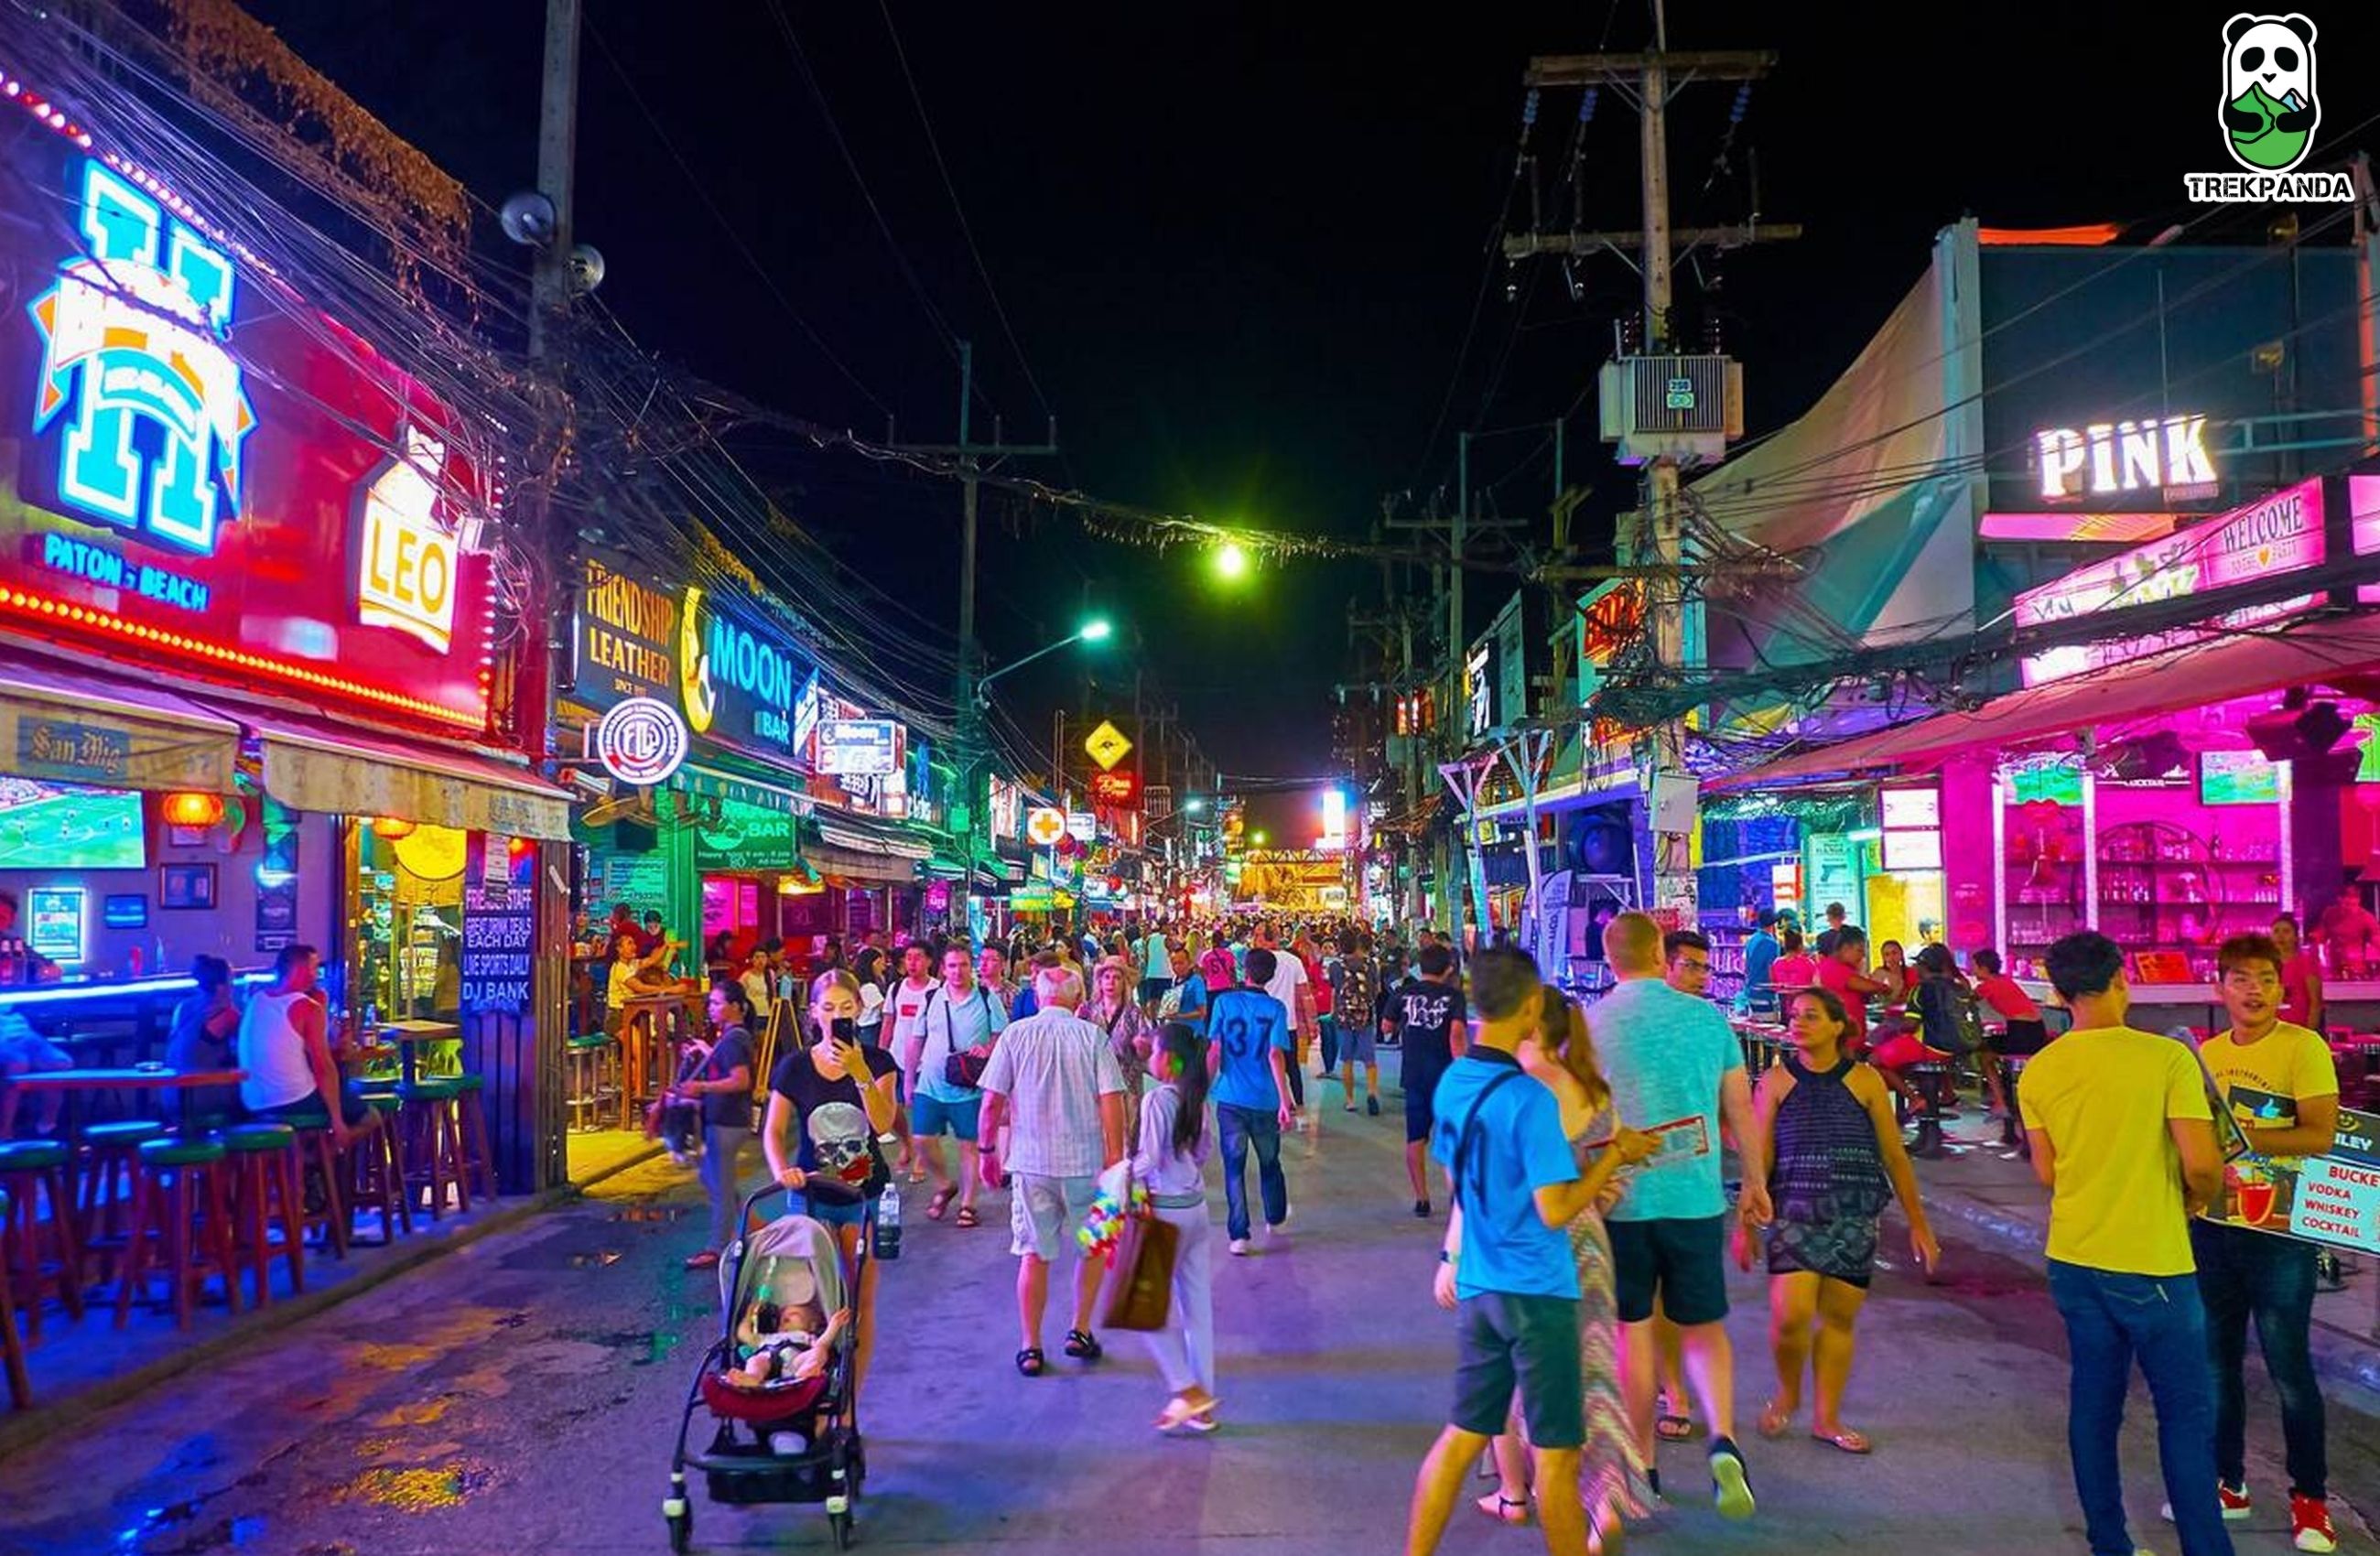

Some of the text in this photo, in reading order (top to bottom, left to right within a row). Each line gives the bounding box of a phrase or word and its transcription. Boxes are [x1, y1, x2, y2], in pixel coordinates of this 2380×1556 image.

[2037, 414, 2217, 497] PINK
[2223, 495, 2303, 554] WELCOME
[370, 518, 448, 614] LEO
[138, 565, 211, 612] BEACH
[587, 559, 675, 647] FRIENDSHIP
[590, 626, 670, 686] LEATHER
[712, 614, 792, 711] MOON
[761, 710, 790, 746] BAR
[747, 822, 790, 838] BAR
[466, 888, 505, 911] FRIE
[467, 934, 528, 948] EACH DAY
[462, 980, 530, 1000] DJ BANK
[1226, 1017, 1274, 1060] 37
[2334, 1131, 2374, 1151] ILEY
[2307, 1181, 2352, 1201] VODKA
[2328, 1164, 2380, 1188] BUCKE
[2304, 1197, 2362, 1220] WHISKEY
[2301, 1216, 2361, 1237] COCKTAIL
